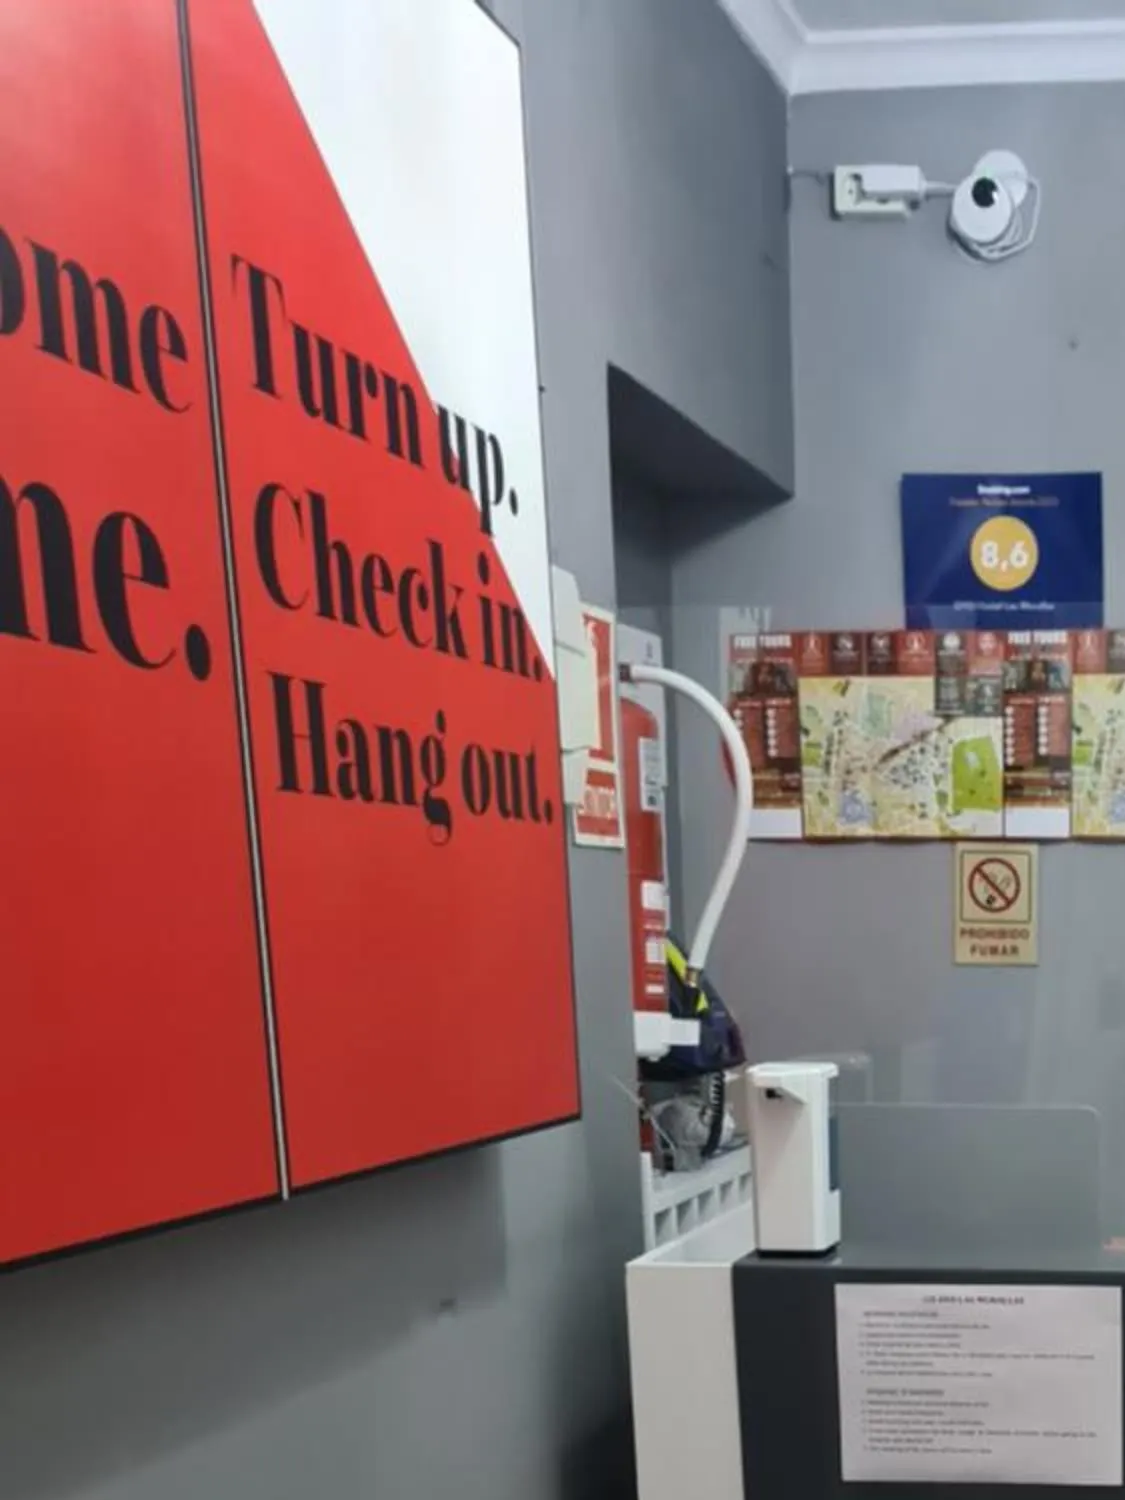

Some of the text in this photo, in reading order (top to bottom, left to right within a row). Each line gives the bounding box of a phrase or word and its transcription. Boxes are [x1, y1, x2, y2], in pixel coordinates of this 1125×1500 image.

[231, 253, 518, 537] Turn up.
[253, 482, 543, 682] Check in.
[265, 670, 454, 846] Hang
[460, 742, 554, 824] out.
[959, 927, 1030, 940] PROHIBIDO
[969, 944, 1020, 957] FUMAR
